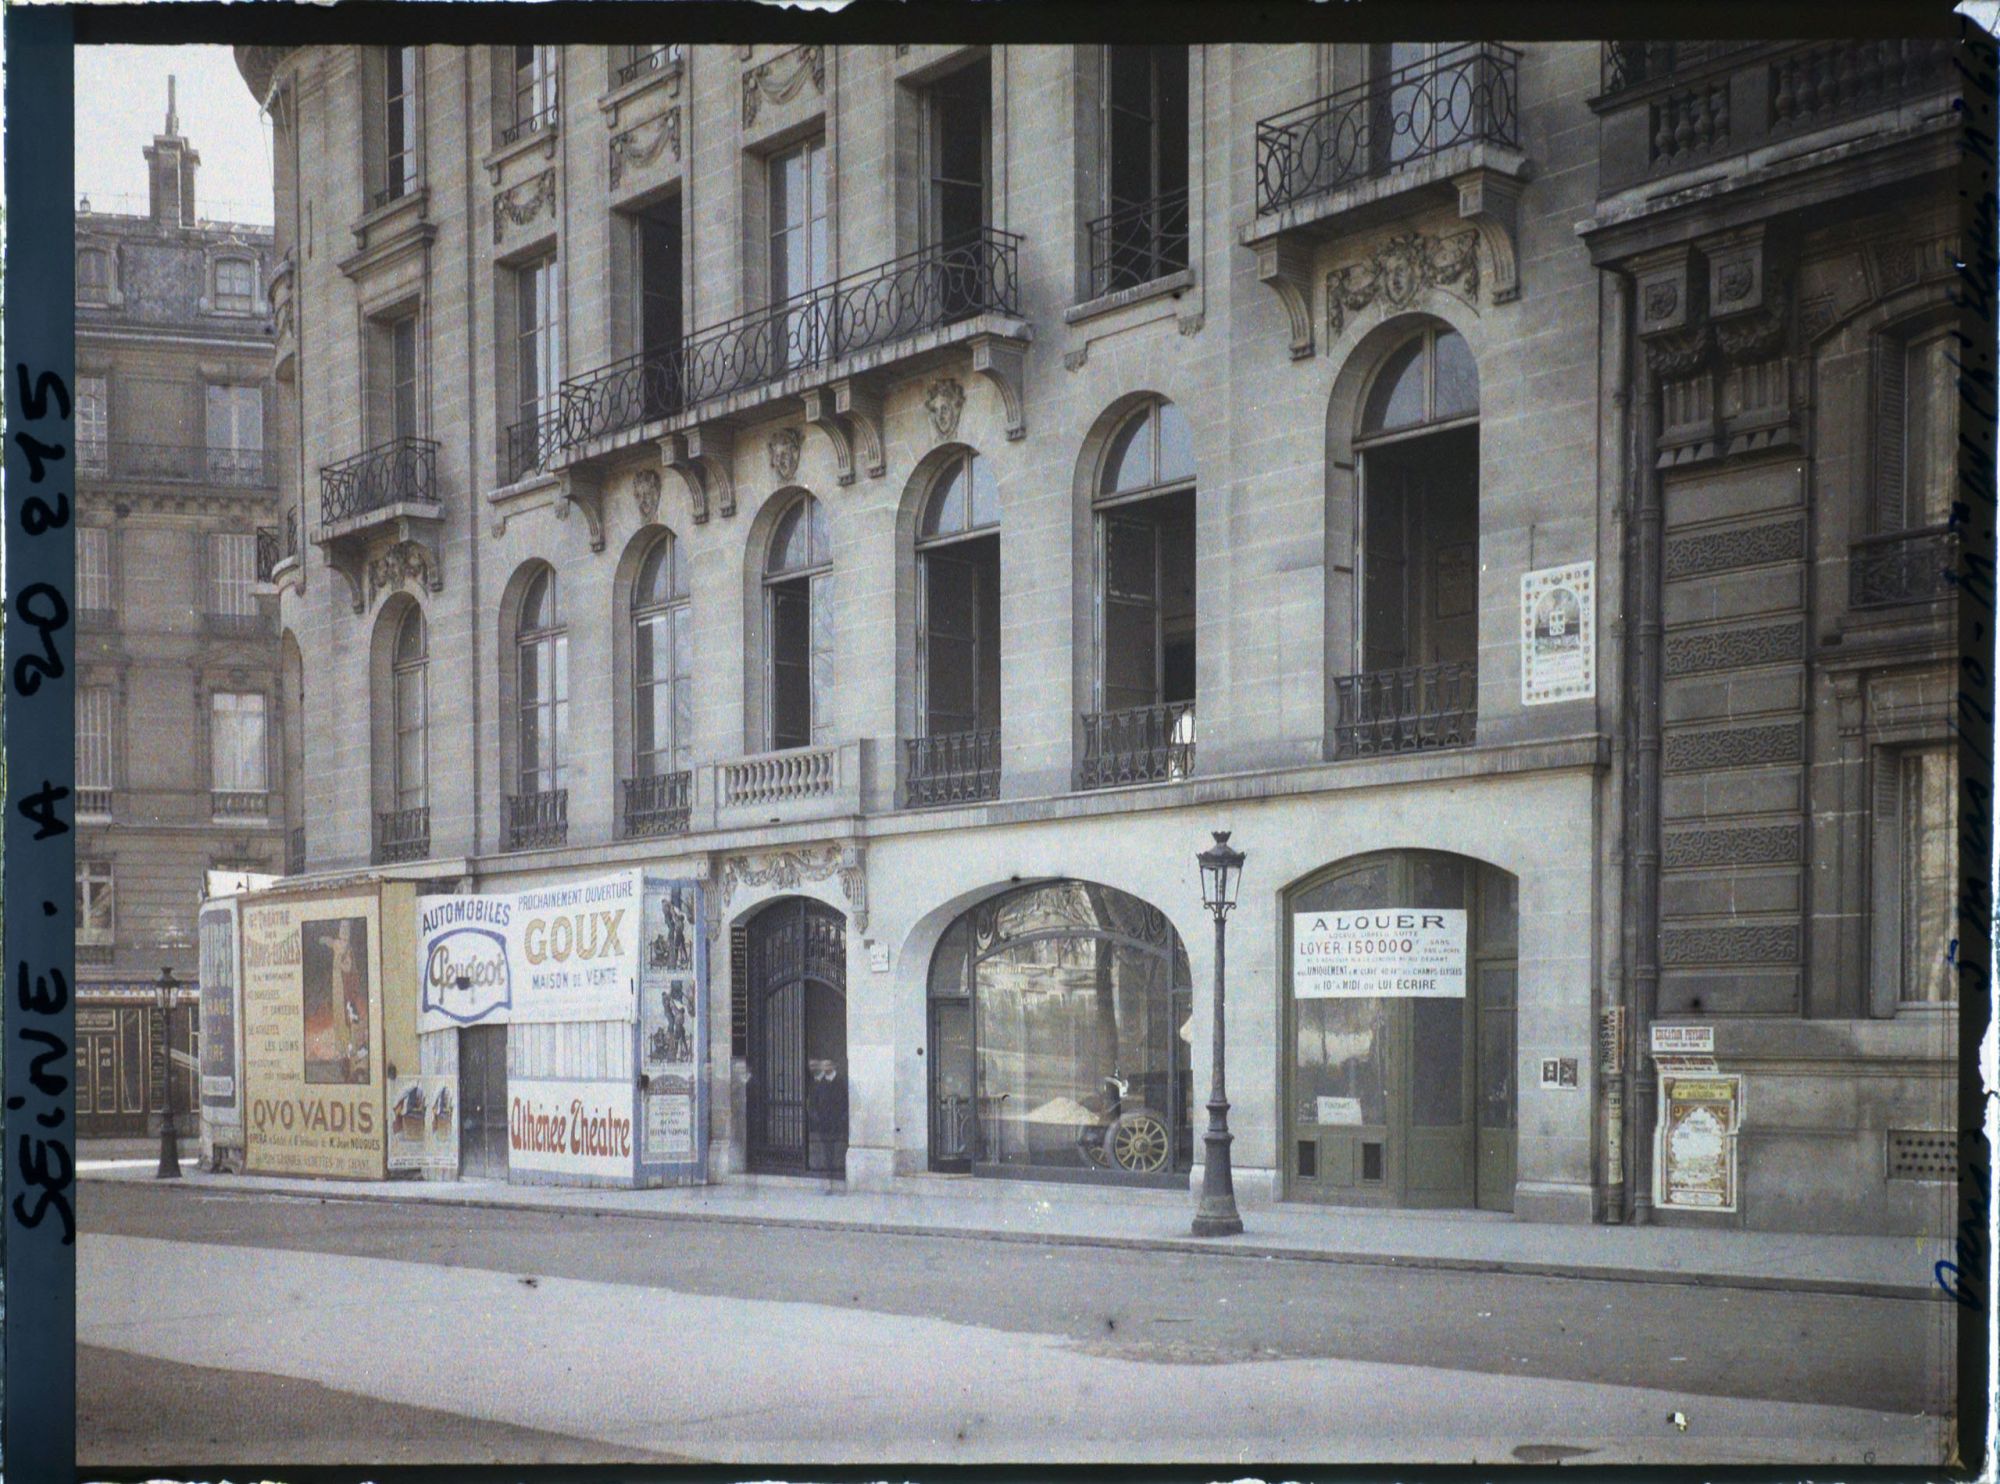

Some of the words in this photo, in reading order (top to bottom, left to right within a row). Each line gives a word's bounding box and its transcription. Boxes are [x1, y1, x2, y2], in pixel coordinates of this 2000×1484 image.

[15, 362, 71, 537] 215
[14, 582, 69, 697] 20
[17, 780, 69, 841] A
[517, 888, 583, 911] PROCHAINEMENT
[585, 880, 633, 904] OUVERTURE
[423, 899, 512, 937] AUTOMOBILES
[1311, 917, 1329, 932] A
[1337, 915, 1445, 930] LOUER
[524, 908, 626, 966] GOUX
[1300, 940, 1342, 956] LOYER
[429, 944, 505, 1006] Peugeot
[532, 970, 569, 990] MAISON
[586, 967, 617, 987] VENTE
[1307, 964, 1348, 977] UNIQUEMENT
[1343, 979, 1360, 991] MIDI
[1378, 979, 1392, 990] LUI
[1396, 978, 1437, 991] ECRIRE
[299, 1099, 374, 1134] VADIS
